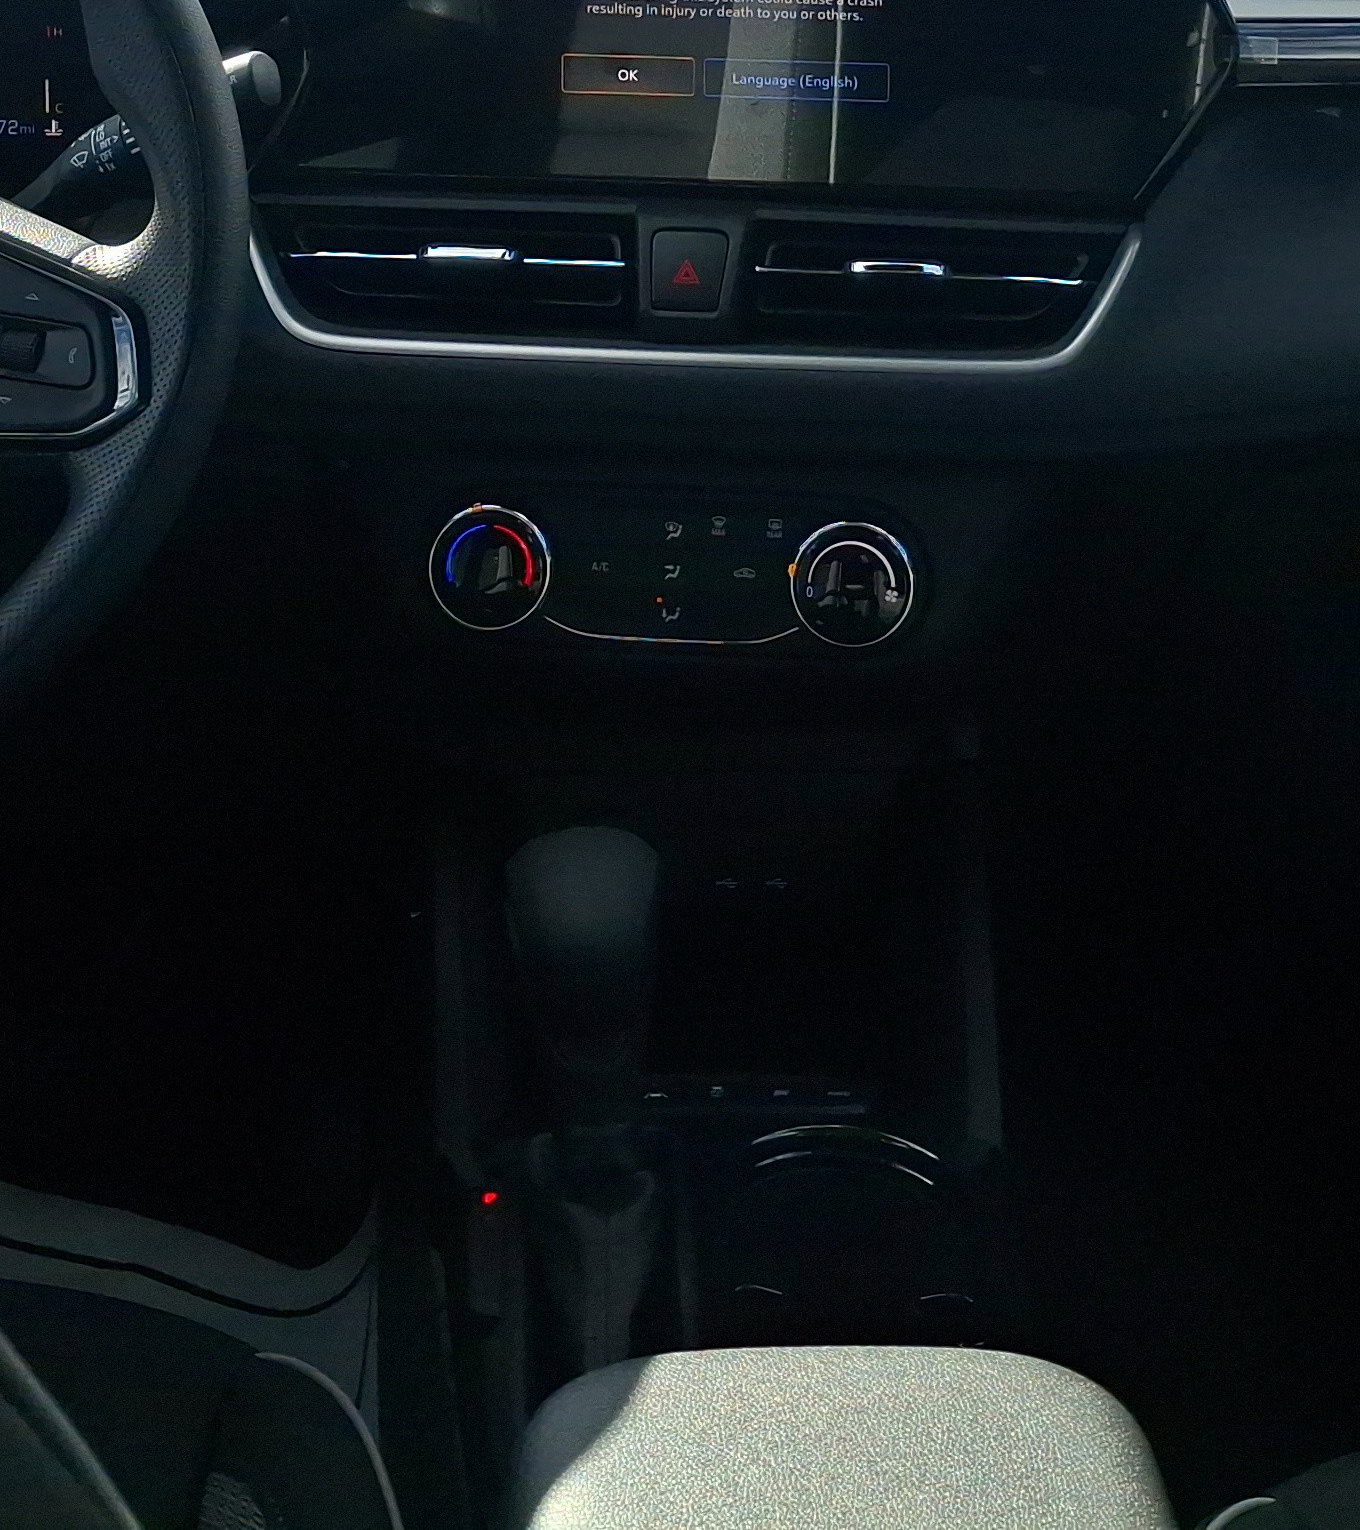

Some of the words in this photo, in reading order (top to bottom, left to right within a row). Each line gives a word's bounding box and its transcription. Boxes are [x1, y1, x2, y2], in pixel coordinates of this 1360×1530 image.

[586, 2, 643, 18] resulting
[646, 3, 658, 16] in
[661, 4, 696, 19] injury
[699, 7, 714, 17] or
[716, 5, 754, 18] death
[757, 7, 770, 19] to
[773, 9, 797, 22] you
[800, 10, 815, 20] or
[817, 8, 864, 22] others.
[617, 69, 639, 82] OK
[732, 73, 796, 89] Language
[799, 74, 858, 91] (English)
[806, 586, 813, 598] 0
